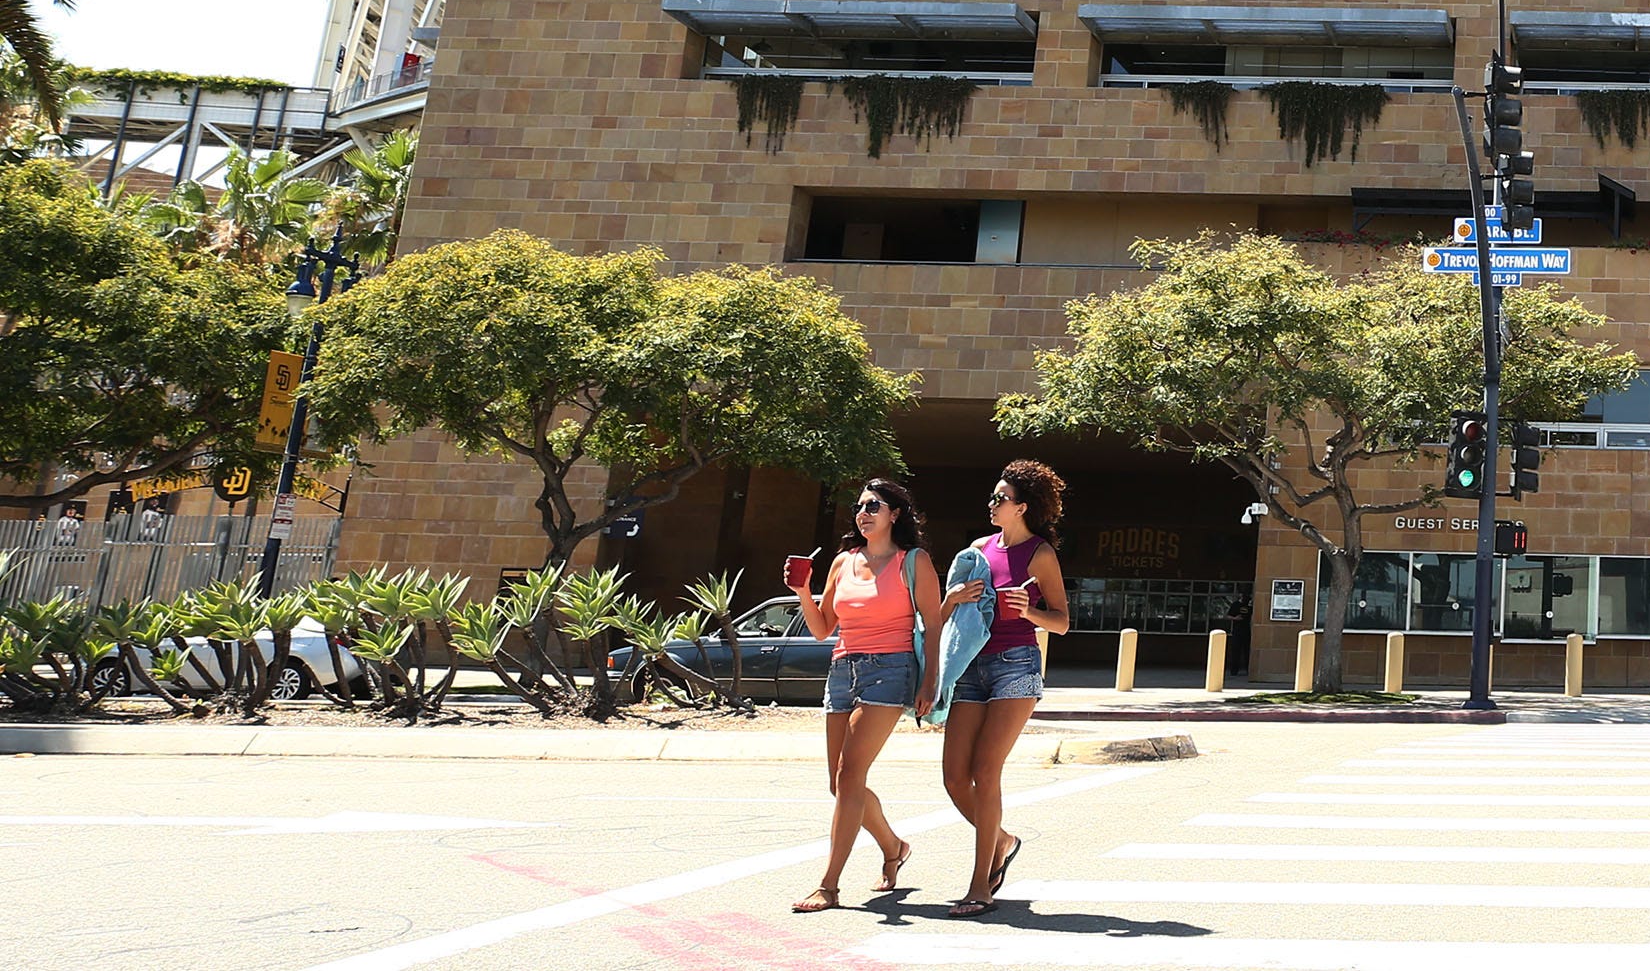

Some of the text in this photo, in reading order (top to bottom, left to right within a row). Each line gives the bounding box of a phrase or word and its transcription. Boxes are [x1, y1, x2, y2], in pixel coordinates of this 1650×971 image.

[1486, 226, 1507, 238] ARK
[1443, 252, 1480, 268] TREVO
[1541, 253, 1566, 268] WAY
[1395, 516, 1445, 529] GUEST
[1096, 527, 1180, 560] PADRES
[1111, 556, 1164, 568] TICKETS
